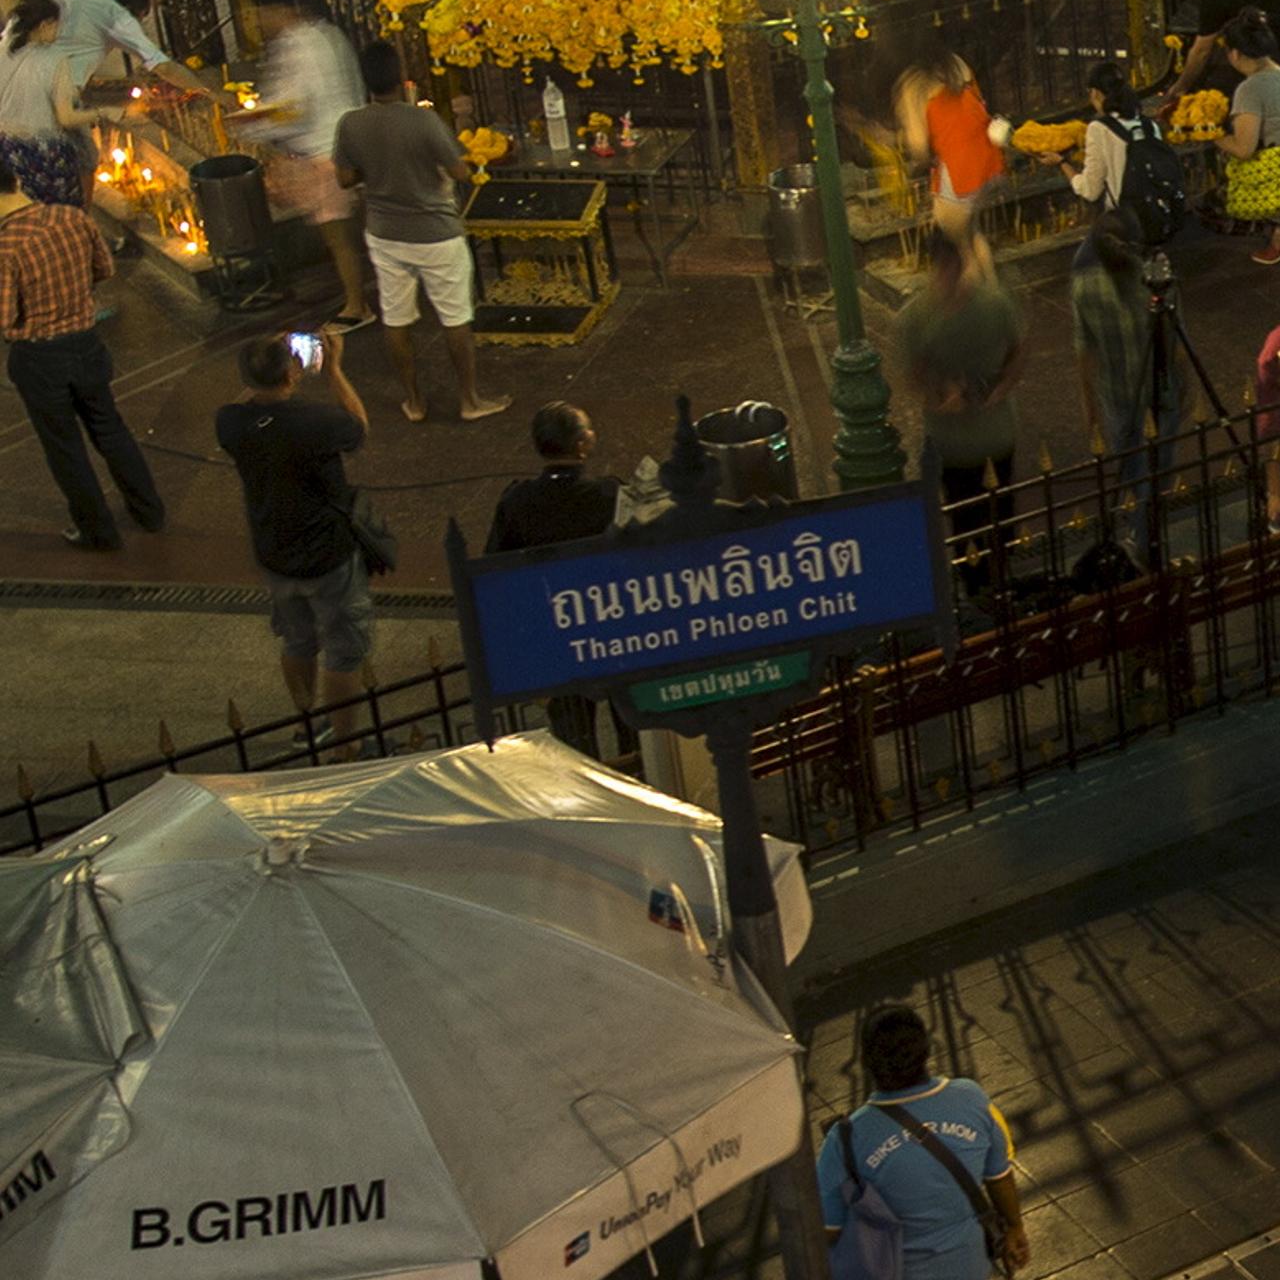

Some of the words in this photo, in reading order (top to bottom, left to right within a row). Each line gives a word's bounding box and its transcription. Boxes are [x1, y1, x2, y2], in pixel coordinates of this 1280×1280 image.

[551, 531, 863, 630] ถนนเพลินจิต
[570, 627, 679, 663] Thanon
[691, 607, 788, 642] Phloen
[799, 592, 857, 620] Chit
[659, 660, 782, 703] เขตปทุมวัน
[707, 1134, 743, 1167] Way
[866, 1134, 902, 1168] BIKE
[902, 1121, 938, 1142] FR
[941, 1121, 978, 1142] MOM
[131, 1179, 386, 1251] B.GRIMM
